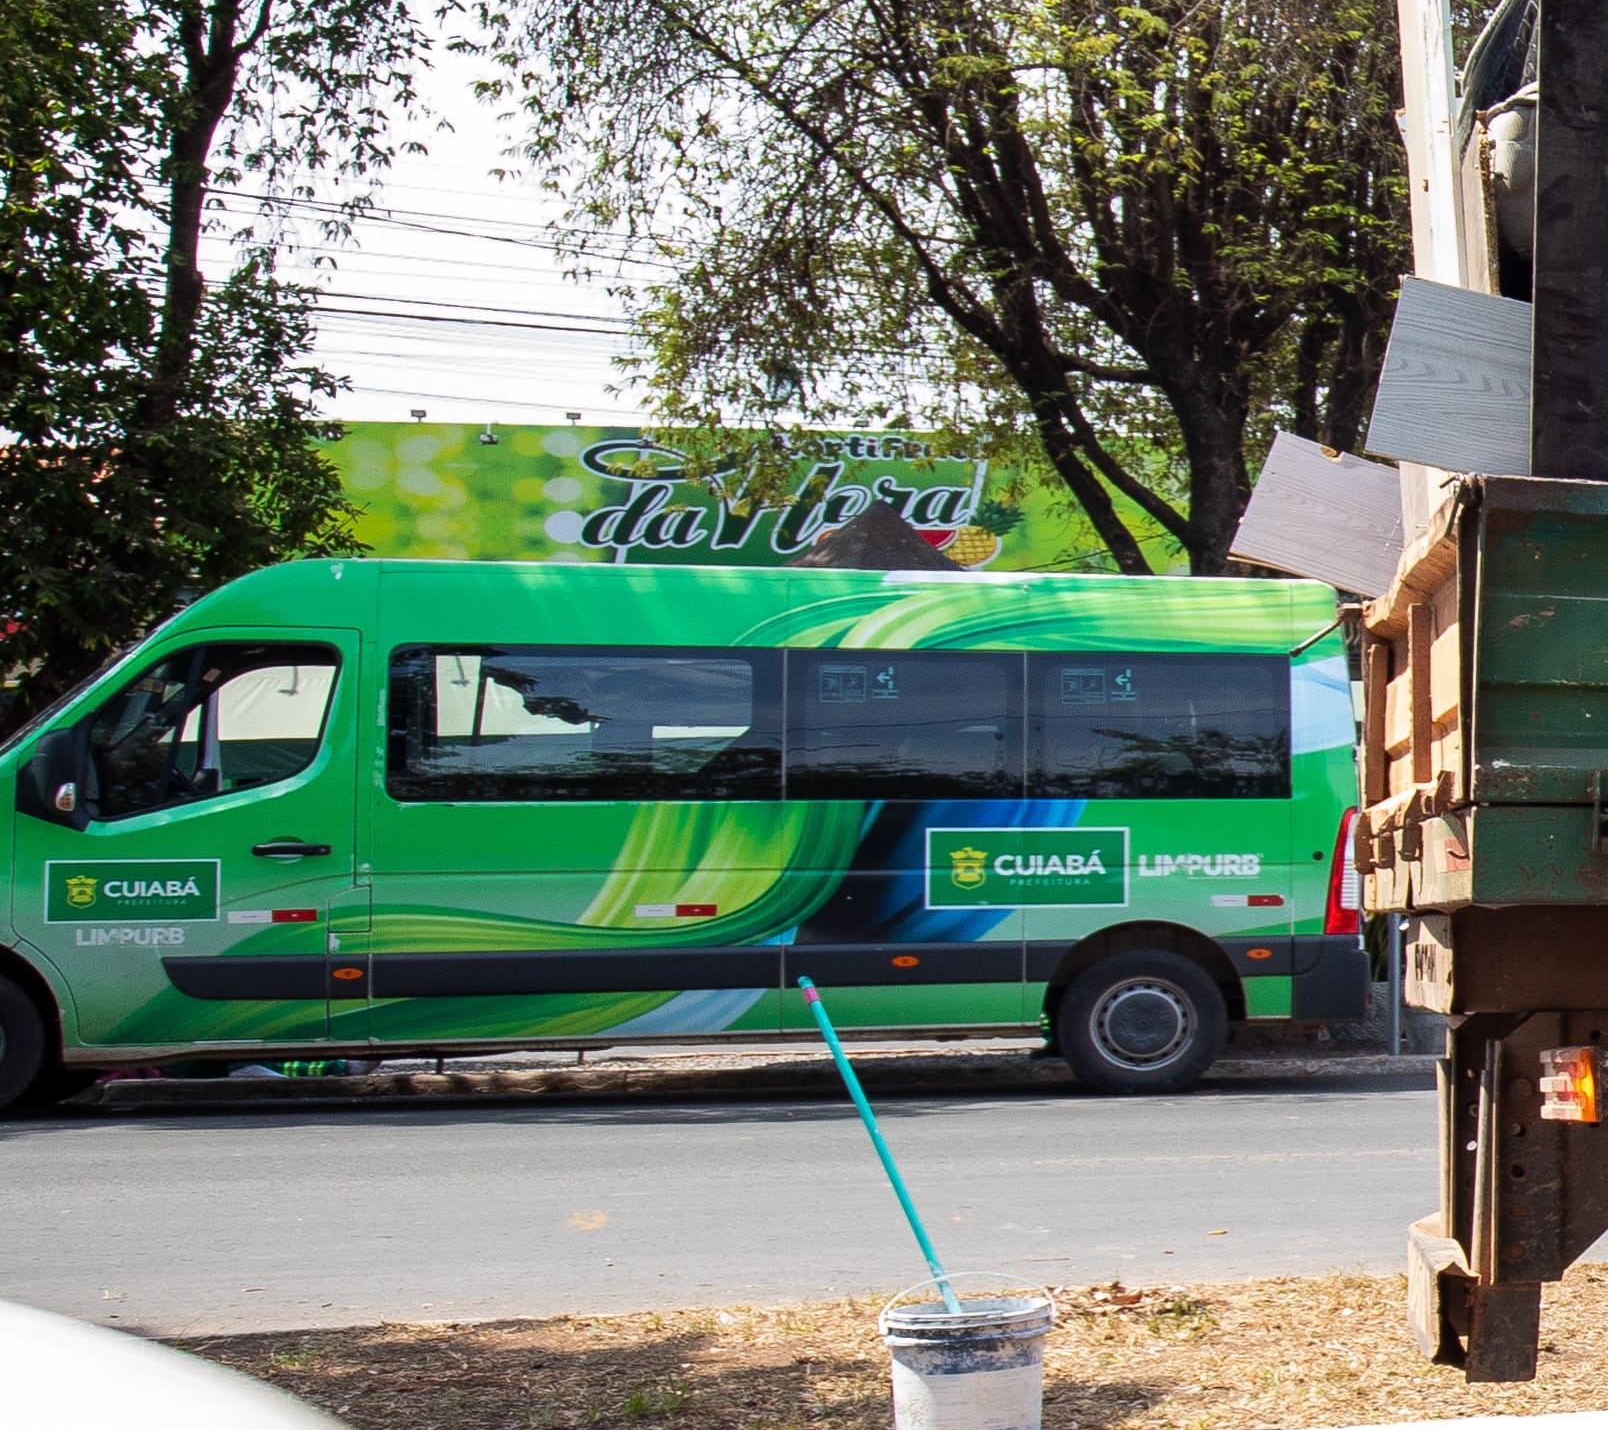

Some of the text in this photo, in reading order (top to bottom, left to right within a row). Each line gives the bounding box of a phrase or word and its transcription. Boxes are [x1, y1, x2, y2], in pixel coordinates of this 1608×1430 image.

[580, 483, 706, 548] da
[993, 849, 1107, 877] CUIABÁ
[103, 876, 201, 898] CUIABÁ
[1009, 878, 1091, 886] PREFEITURA
[116, 898, 187, 906] PREFEITURA
